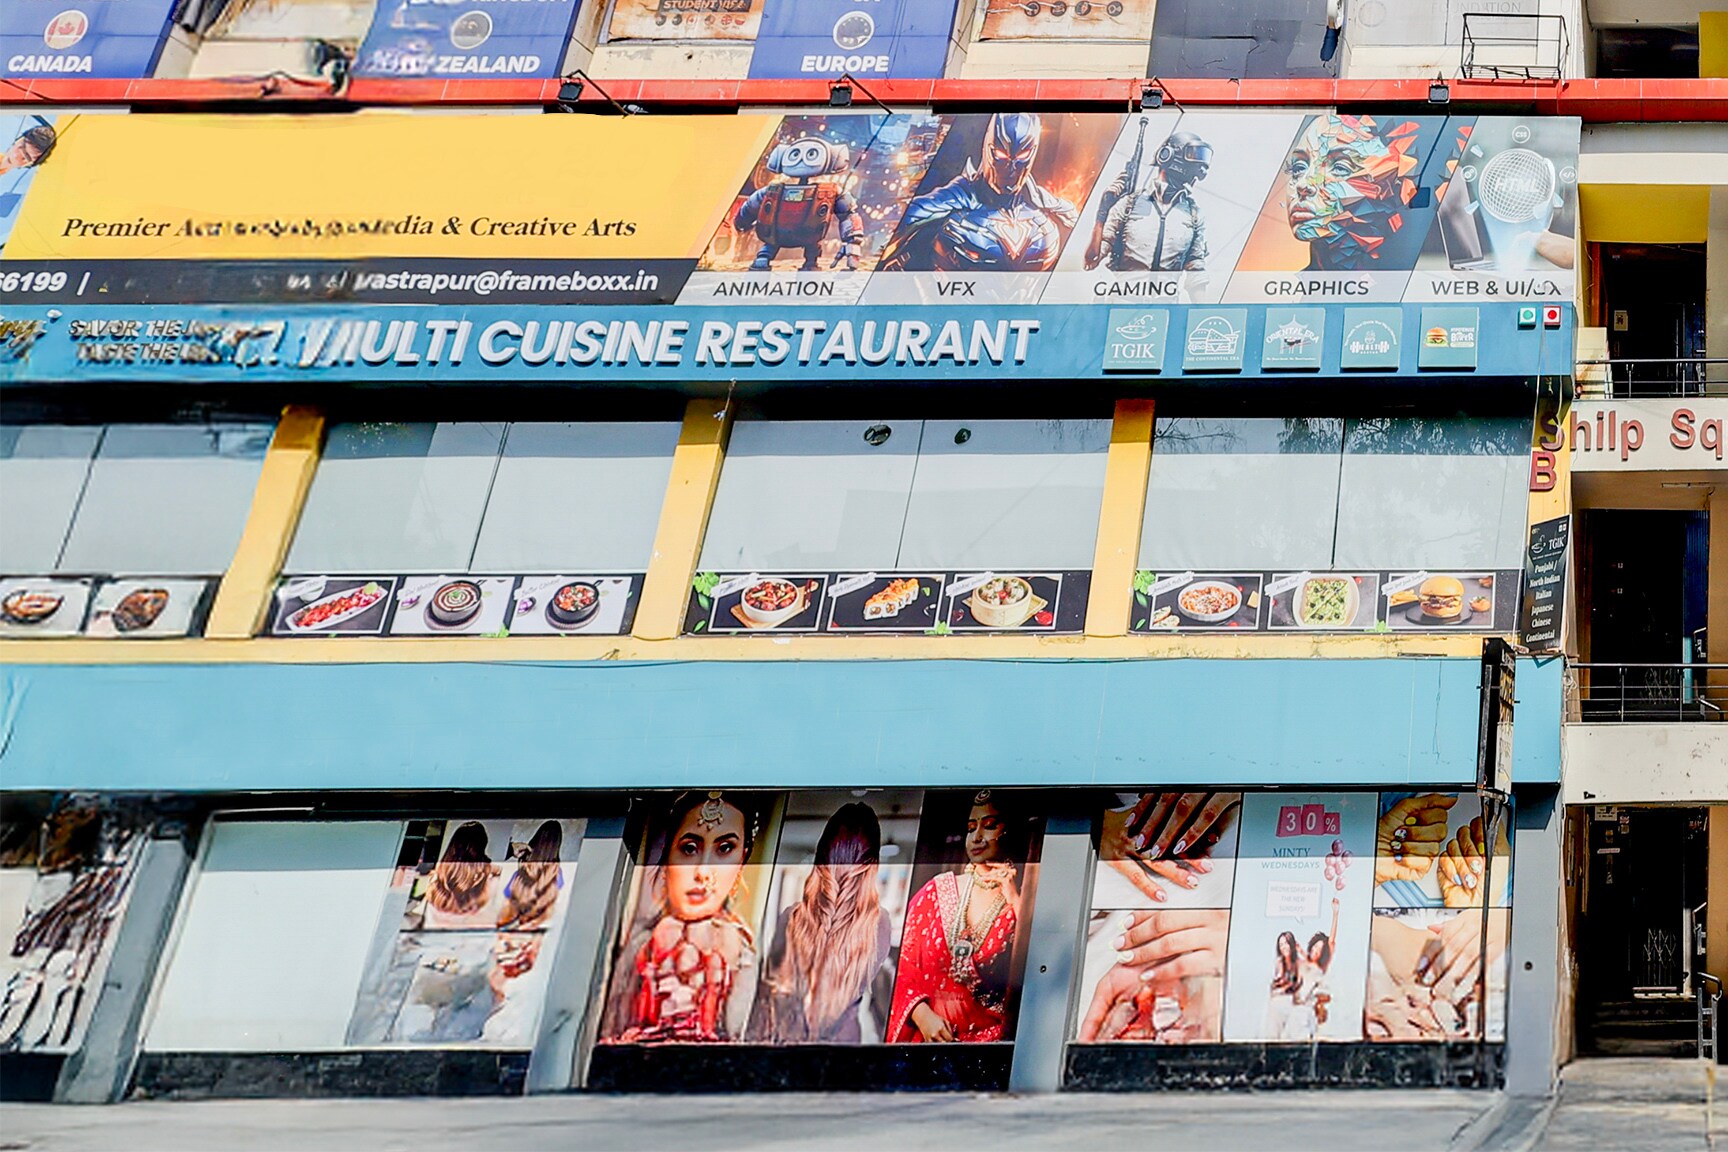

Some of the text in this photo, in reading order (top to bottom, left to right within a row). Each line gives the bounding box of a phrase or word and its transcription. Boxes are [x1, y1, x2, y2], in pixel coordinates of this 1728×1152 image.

[663, 0, 718, 9] STUDENT
[8, 55, 92, 72] CANADA
[434, 56, 540, 73] ZEALAND
[801, 56, 890, 72] EUROPE
[61, 217, 171, 237] Premier
[441, 217, 464, 236] &
[471, 216, 577, 236] Creative
[582, 217, 637, 236] Arts
[713, 281, 835, 296] ANIMATION
[936, 281, 977, 296] VFX
[1094, 281, 1177, 296] GAMING
[1264, 280, 1369, 296] GRAPHICS
[1432, 280, 1499, 295] WEB &
[477, 319, 690, 366] CUISINE
[695, 319, 1041, 365] RESTAURANT
[1111, 343, 1155, 359] TGIK
[1539, 410, 1645, 461] Shilp
[1529, 451, 1557, 492] B
[1548, 536, 1565, 551] TGIK
[1530, 574, 1560, 588] North Indian
[1535, 589, 1552, 600] Italian
[1531, 603, 1554, 616] Japanese
[1531, 618, 1552, 628] Chinese
[1526, 629, 1555, 643] Continental
[1286, 812, 1336, 832] 30%
[1272, 848, 1311, 857] MINTY
